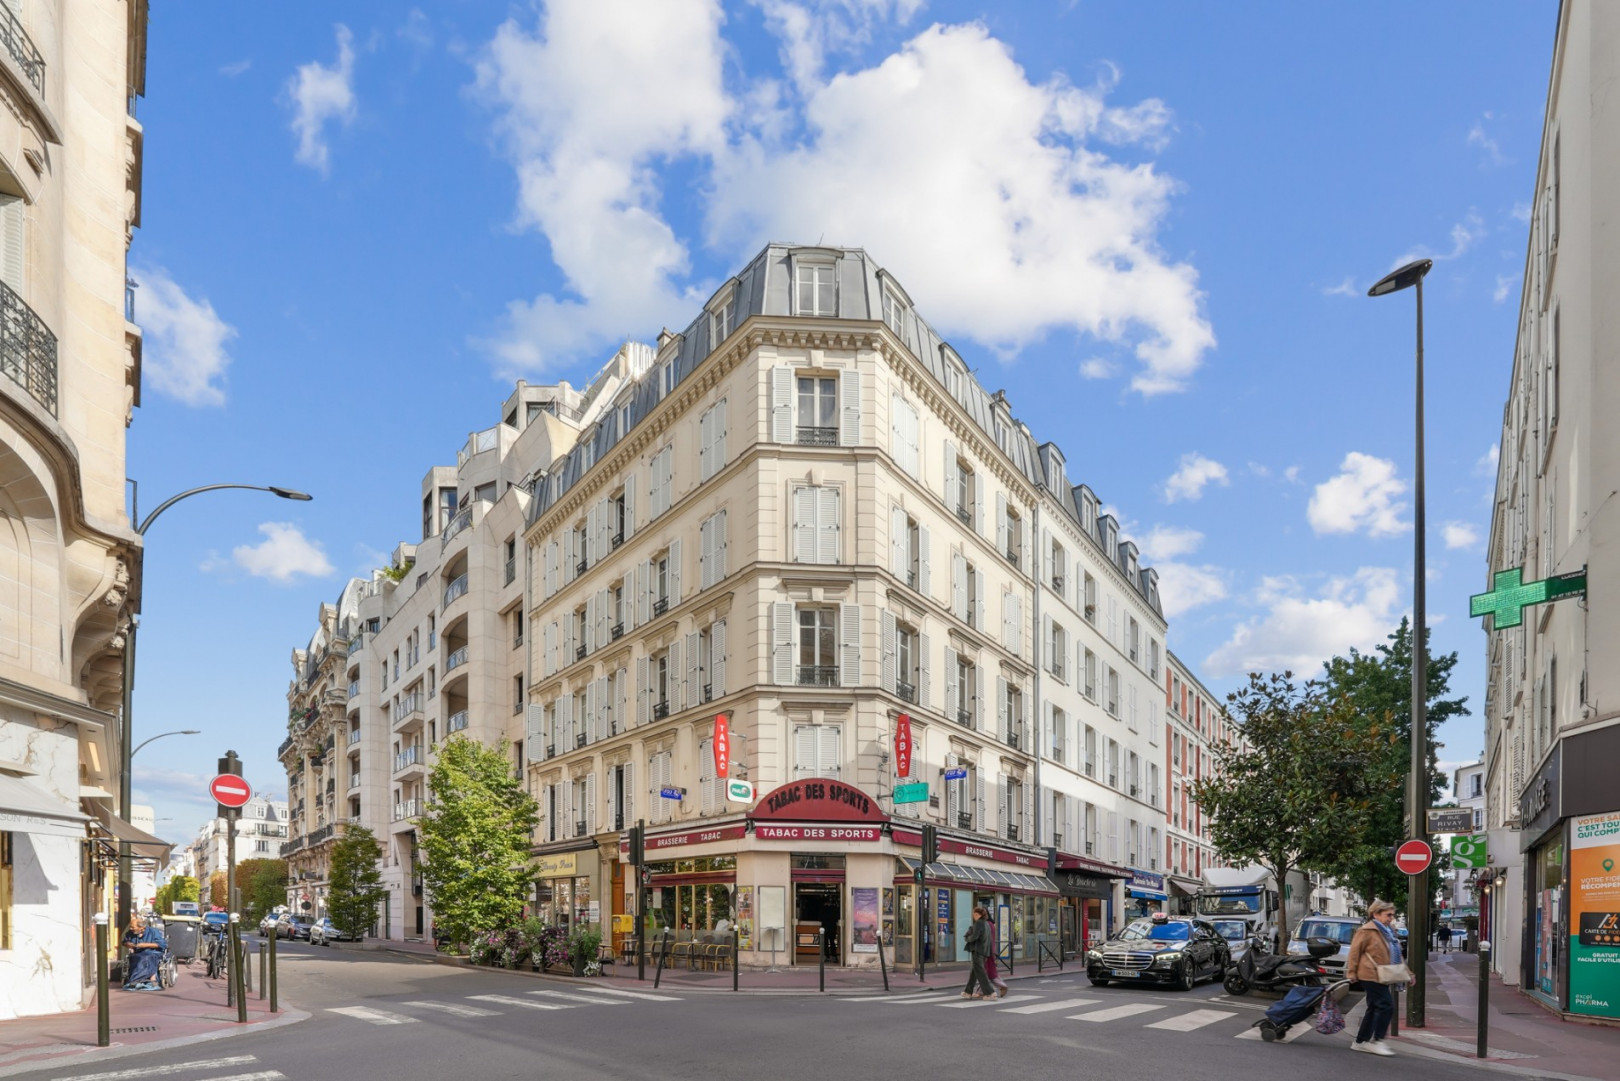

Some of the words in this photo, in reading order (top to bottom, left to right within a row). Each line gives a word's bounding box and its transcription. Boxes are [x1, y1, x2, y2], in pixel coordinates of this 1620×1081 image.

[768, 786, 801, 813] TABAC
[806, 784, 825, 800] DES
[830, 785, 869, 814] SPORTS
[1578, 816, 1605, 825] VOTRE
[763, 828, 798, 837] TABAC
[1578, 824, 1600, 832] C'EST
[1594, 828, 1620, 836] COMP
[658, 836, 688, 847] BRASSERIE
[700, 832, 721, 841] TABAC
[966, 846, 993, 858] BRASSERIE
[1016, 856, 1029, 864] TABAC
